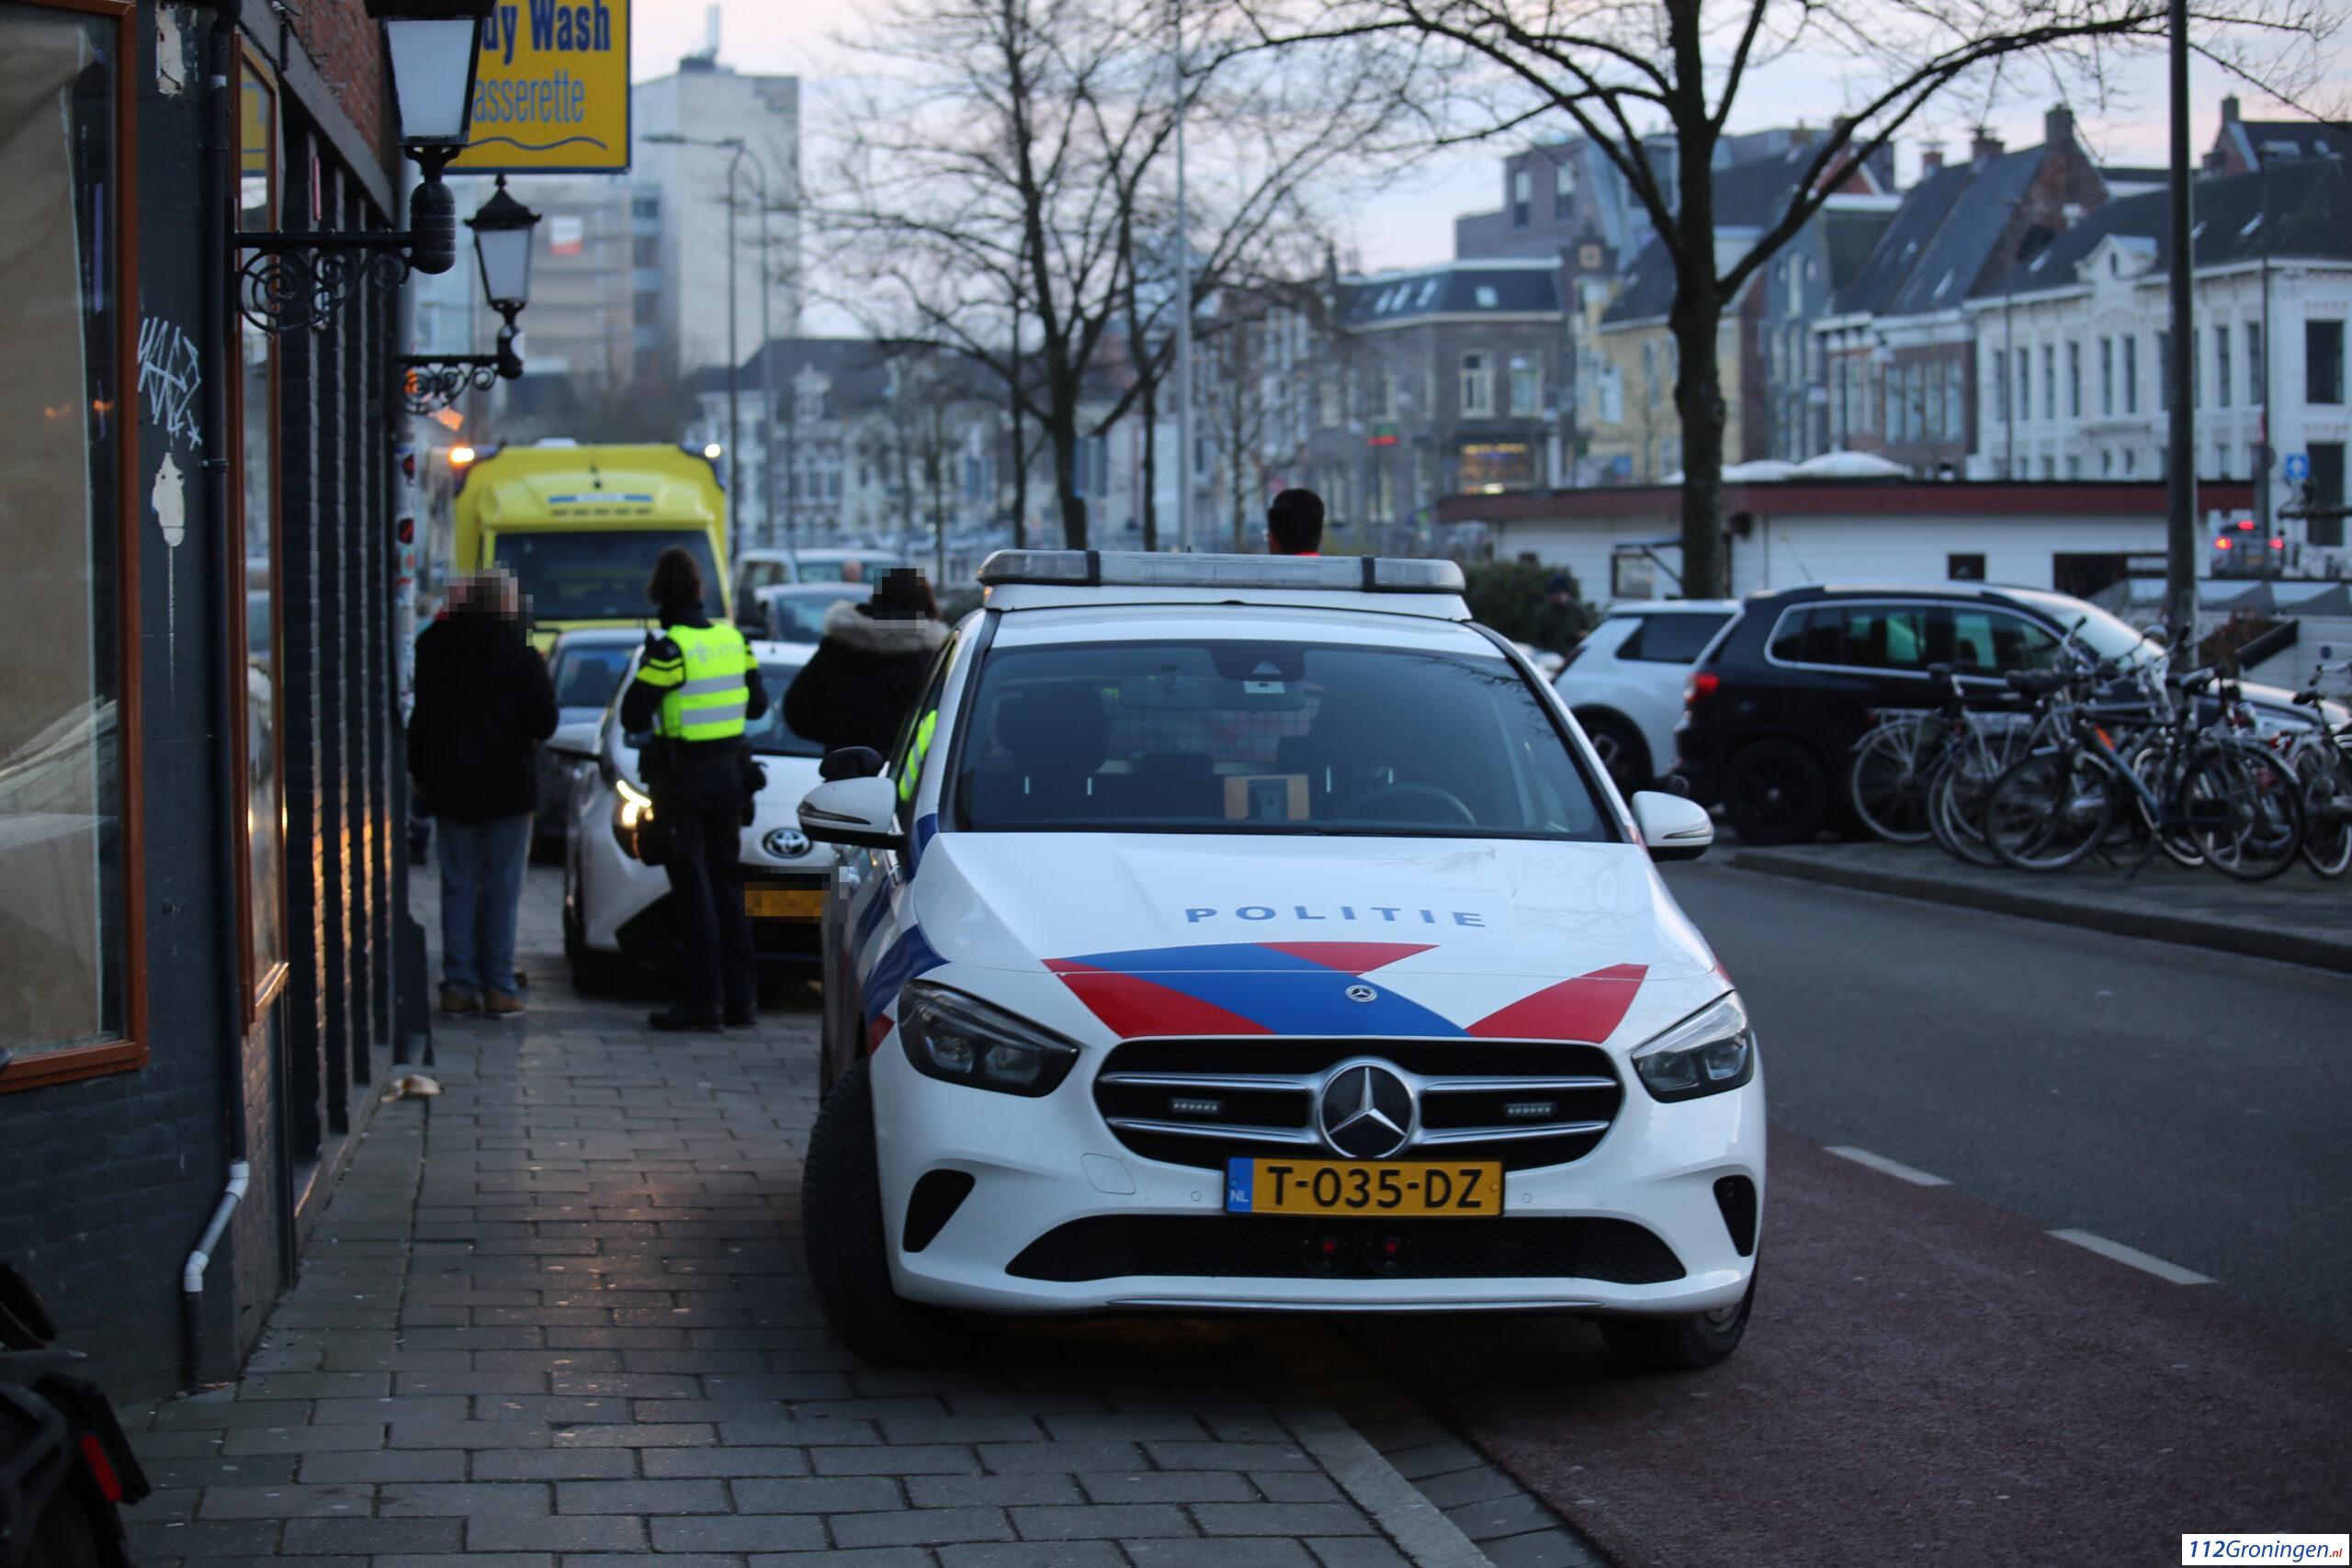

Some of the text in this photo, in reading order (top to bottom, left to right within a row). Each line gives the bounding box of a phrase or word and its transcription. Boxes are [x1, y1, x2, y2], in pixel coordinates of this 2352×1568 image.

[528, 0, 611, 51] Wash
[474, 70, 585, 123] asserette
[1184, 905, 1487, 928] POLITIE
[1229, 1189, 1250, 1202] NL
[1266, 1165, 1483, 1209] T-035-DZ
